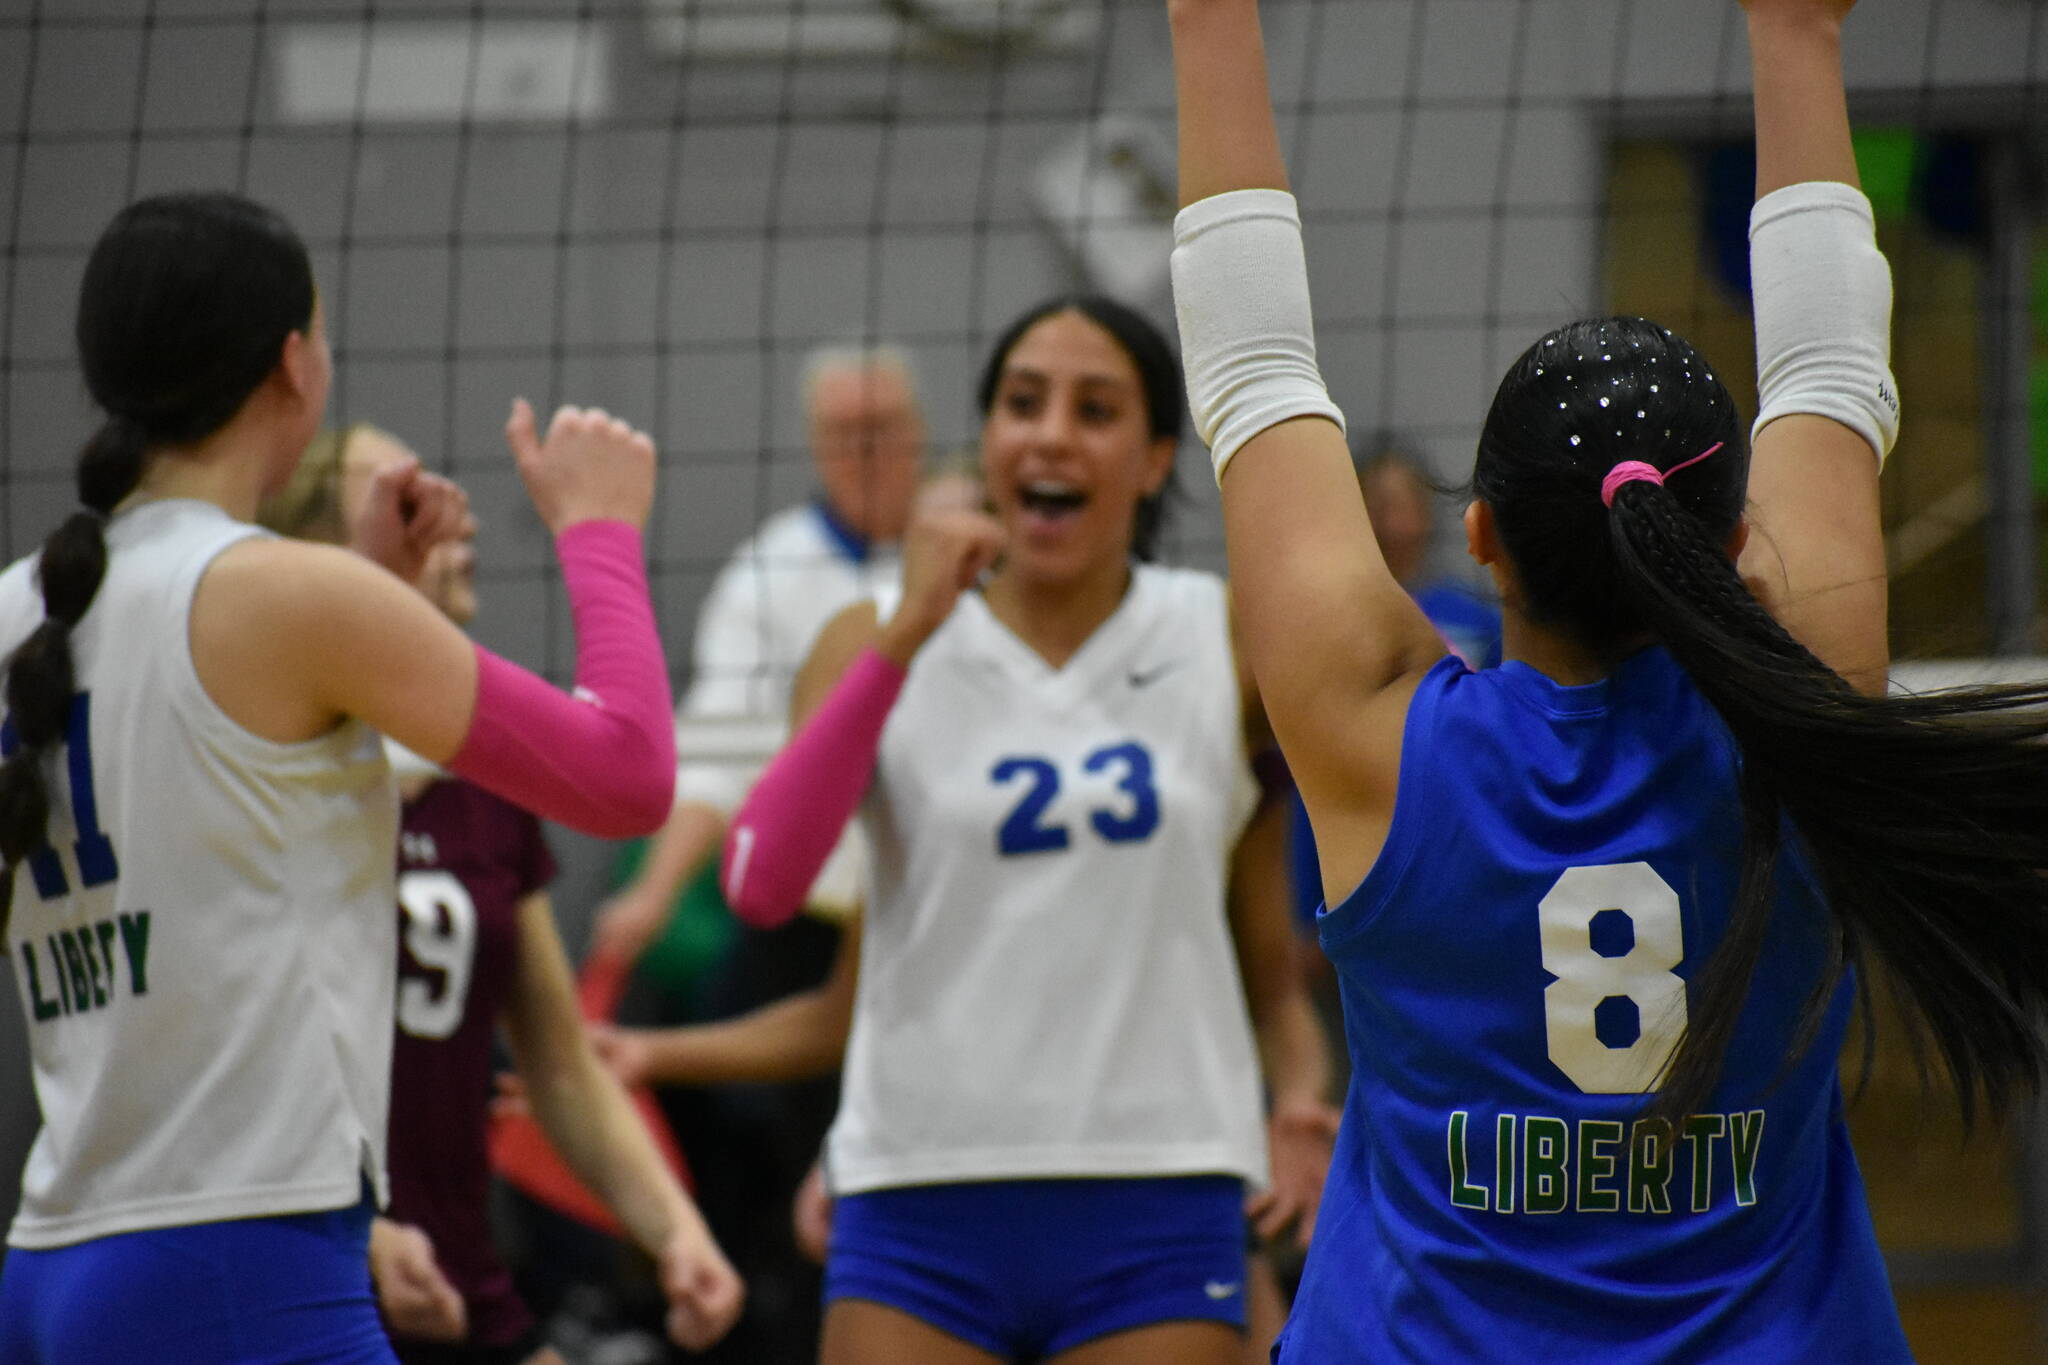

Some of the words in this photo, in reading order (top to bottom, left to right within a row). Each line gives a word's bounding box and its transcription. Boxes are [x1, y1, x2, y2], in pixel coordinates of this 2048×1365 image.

[989, 741, 1159, 855] 23
[1538, 861, 1688, 1093] 8
[1448, 1110, 1765, 1214] LIBERTY
